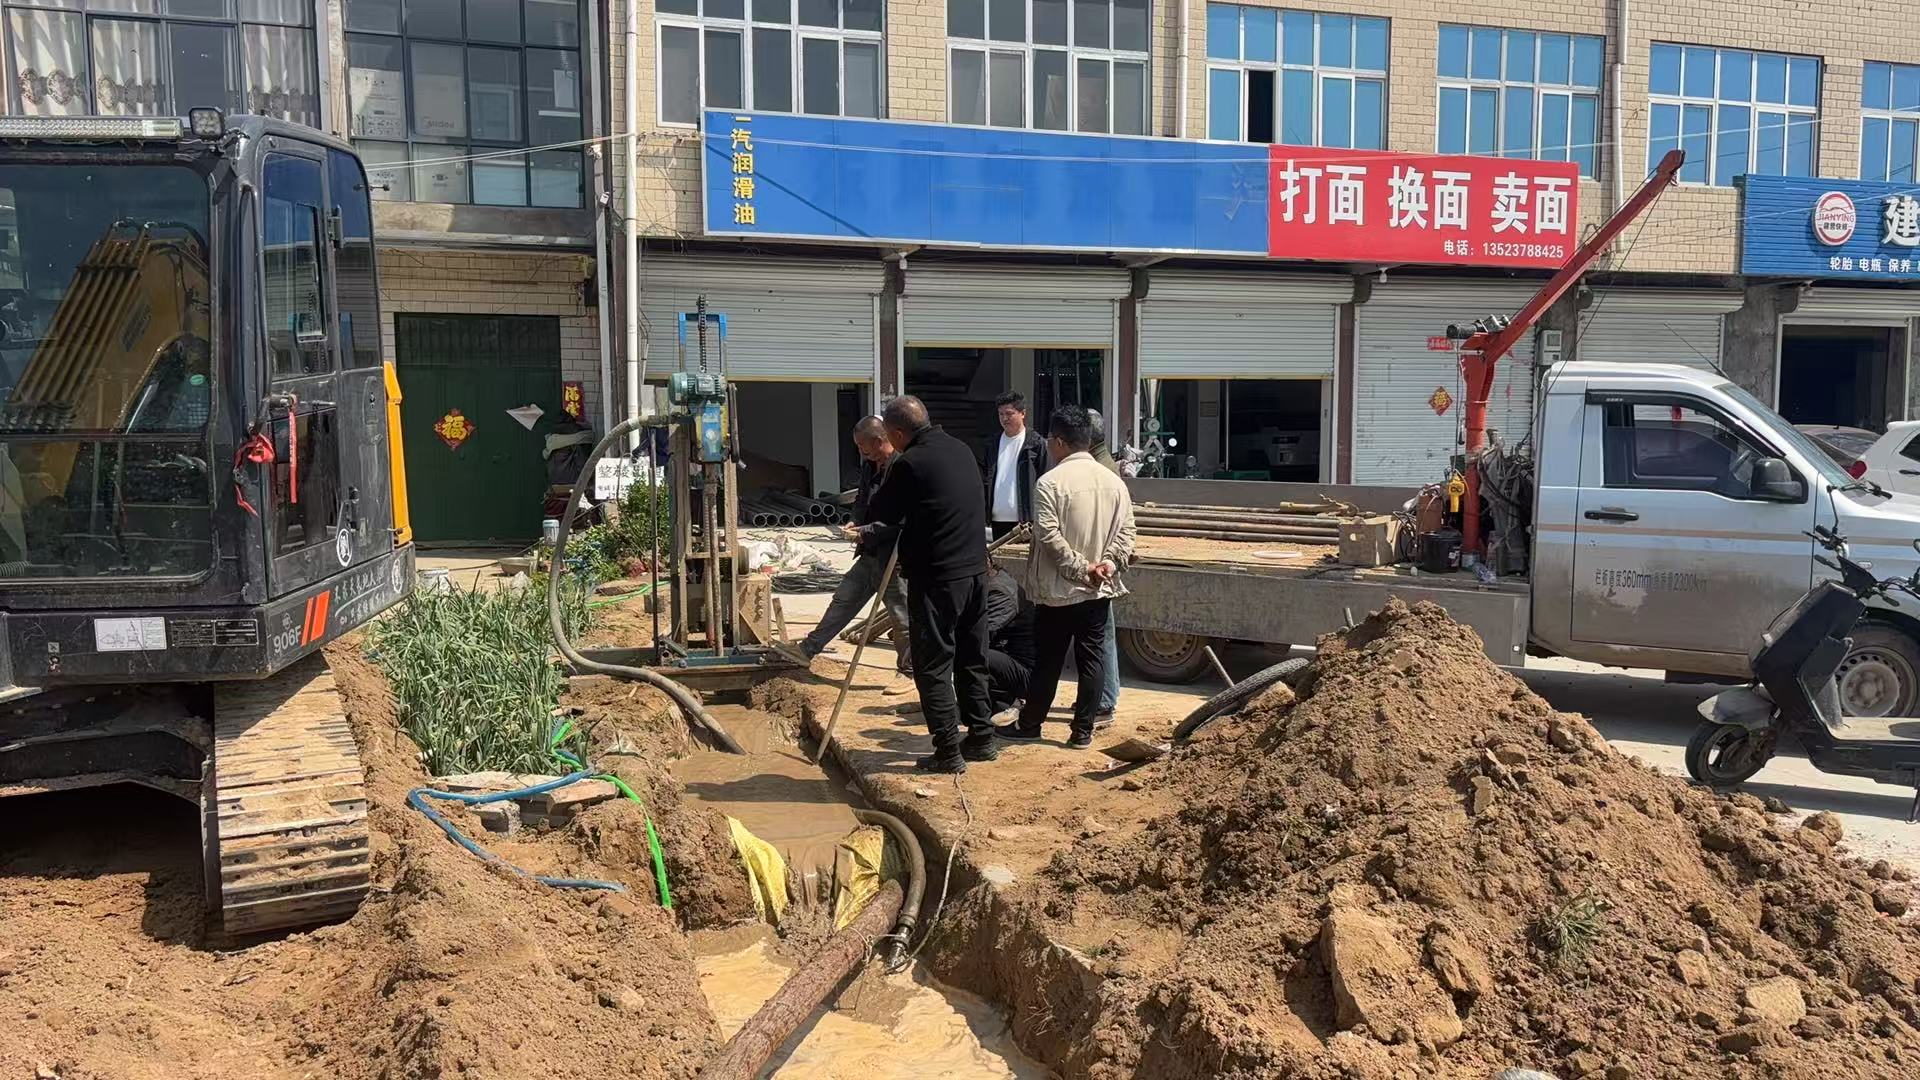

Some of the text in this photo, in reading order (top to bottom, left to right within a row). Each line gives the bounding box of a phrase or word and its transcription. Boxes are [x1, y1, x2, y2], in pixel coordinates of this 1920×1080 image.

[731, 116, 755, 225] 一汽润滑油
[1279, 159, 1572, 235] 打面 换面 卖面
[1817, 213, 1855, 223] JIANYING
[1881, 195, 1920, 246] 建
[1482, 242, 1564, 258] 13523788425
[1829, 256, 1853, 271] 轮胎
[1859, 258, 1881, 272] 电瓶
[1888, 259, 1911, 273] 保养
[442, 415, 467, 440] 福
[273, 625, 302, 653] 906F
